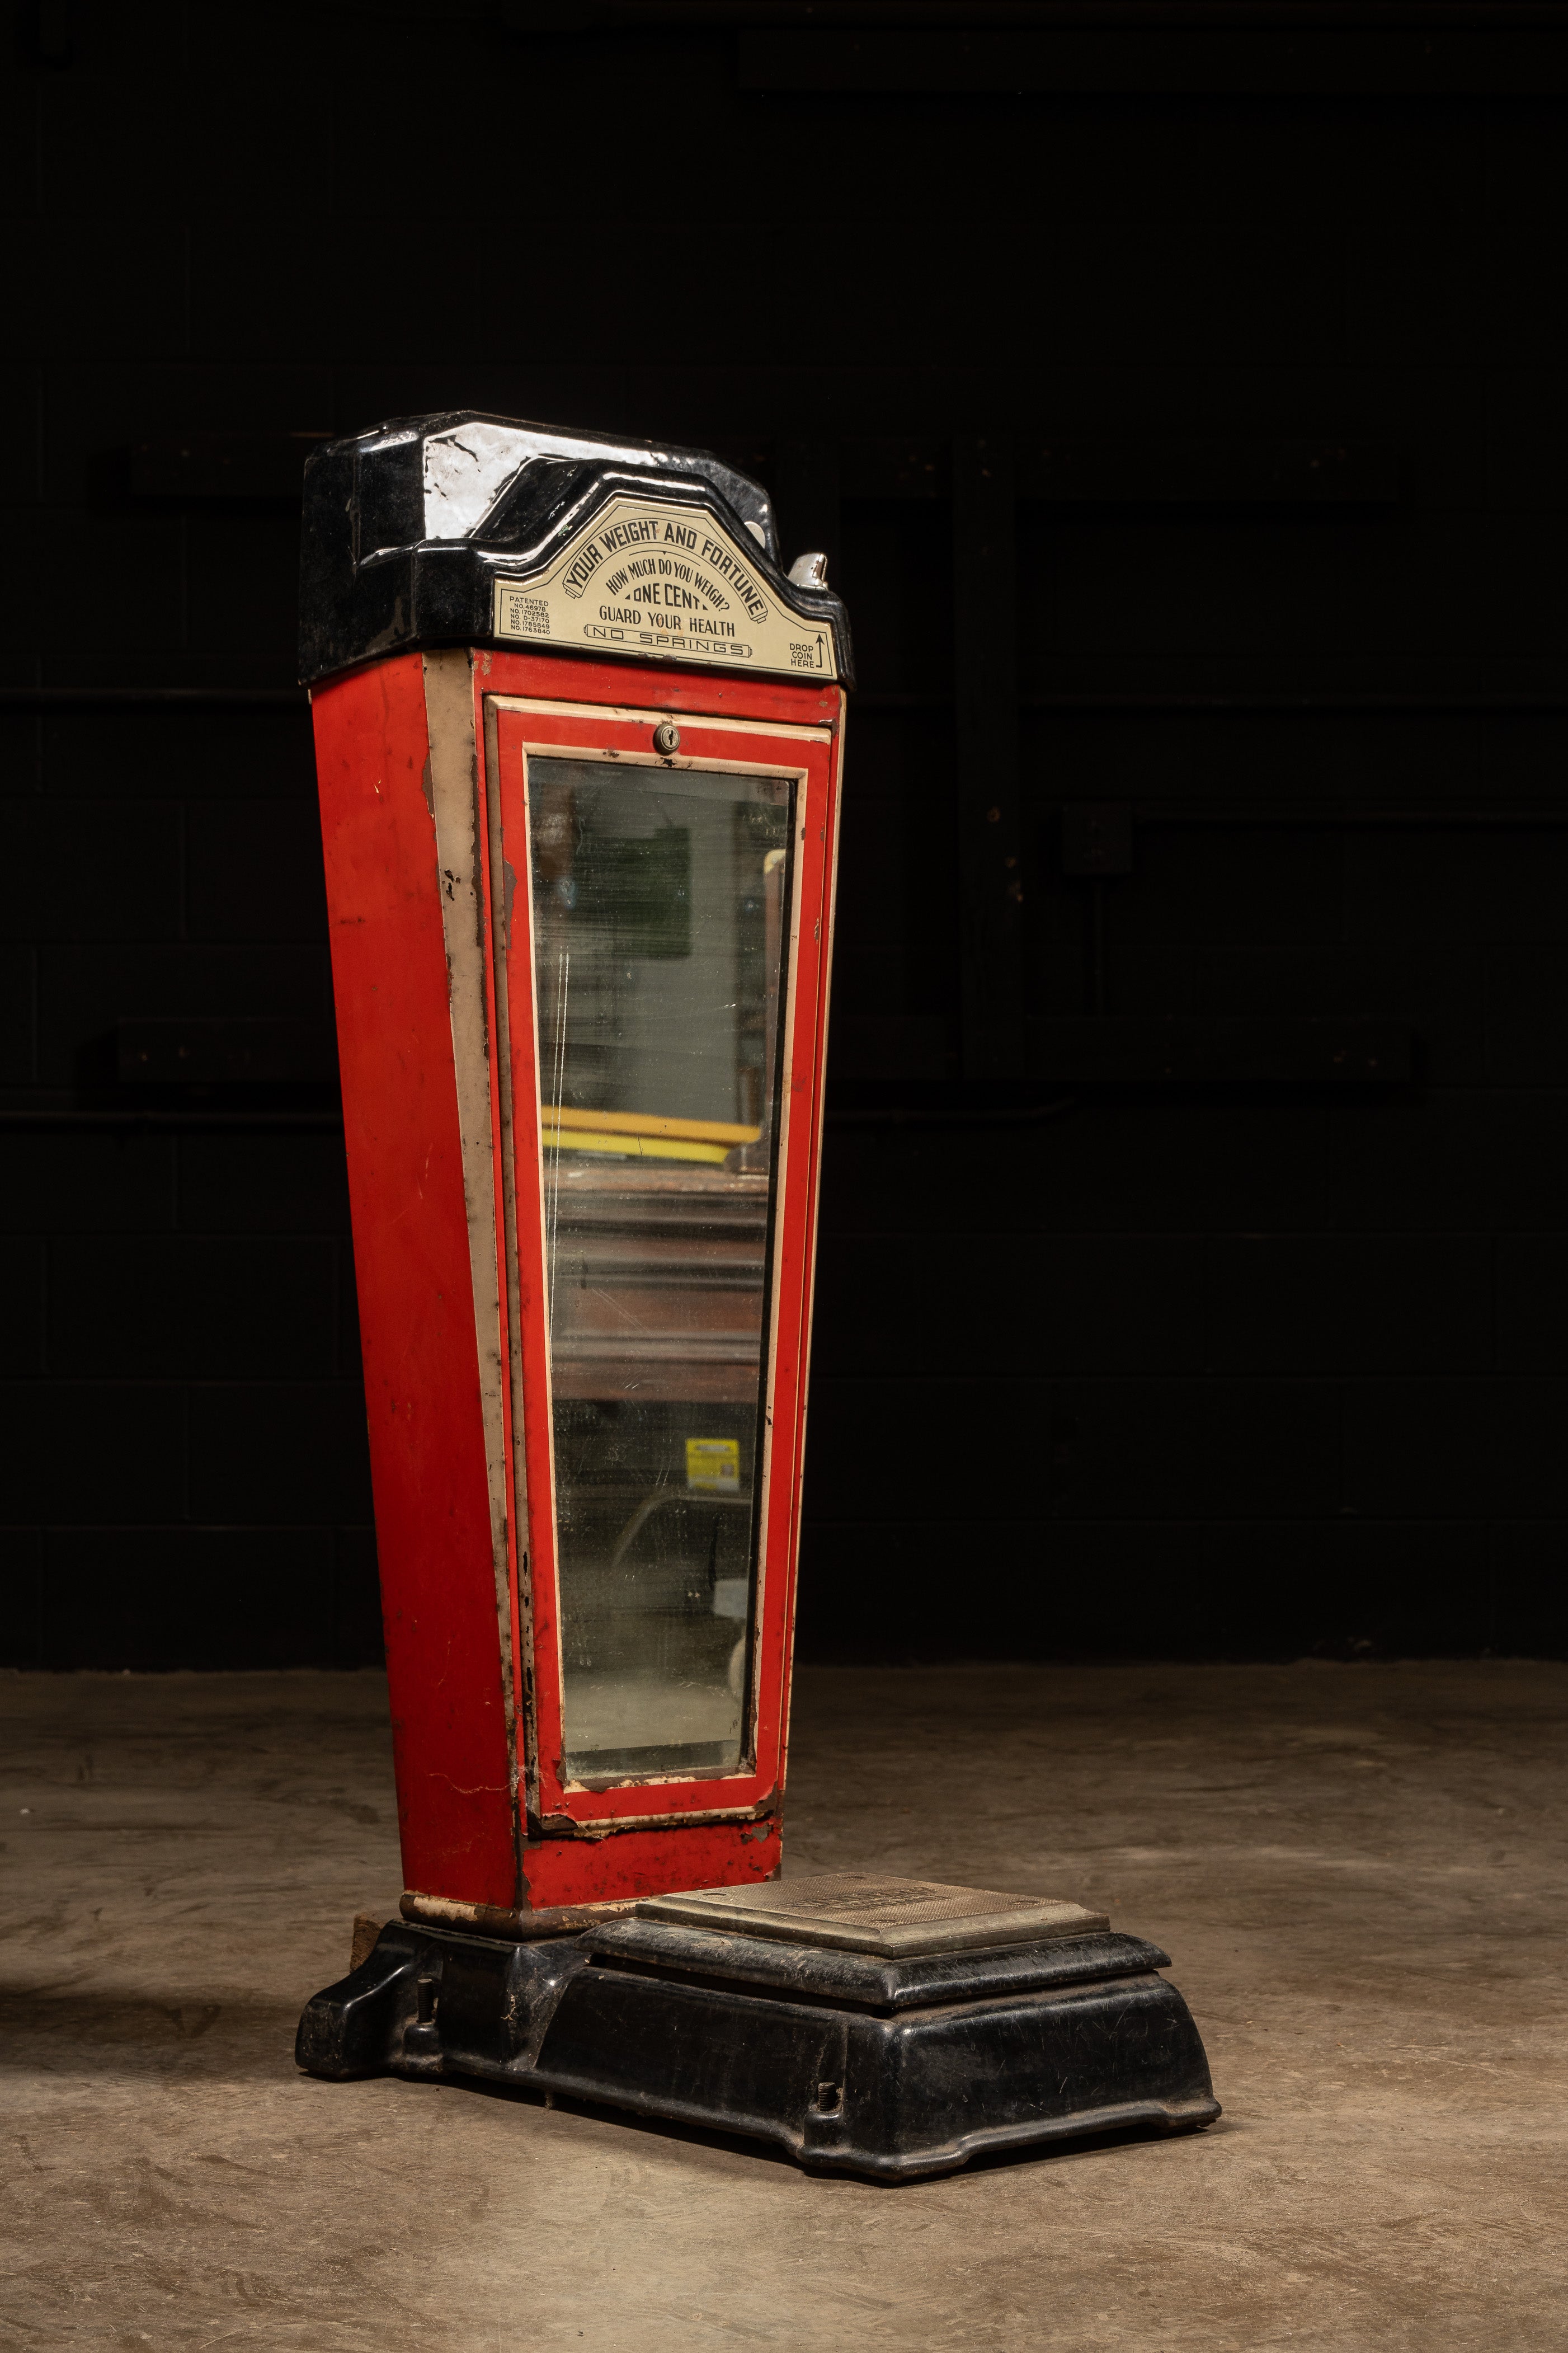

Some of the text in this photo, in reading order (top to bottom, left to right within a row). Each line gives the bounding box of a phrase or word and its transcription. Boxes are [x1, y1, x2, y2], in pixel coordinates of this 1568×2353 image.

[566, 520, 764, 616] YOUR WEIGHT AND FORTUNE
[605, 558, 730, 612] HOW MUCH DO YOU WEIGH?
[633, 583, 700, 610] ONE CENT
[510, 596, 549, 607] PATENTED
[599, 605, 735, 637] GUARD YOUR HEALTH
[593, 627, 743, 655] NO SPRINGS
[790, 643, 813, 652] DROP
[791, 659, 814, 669] HERE
[792, 651, 812, 660] COIN
